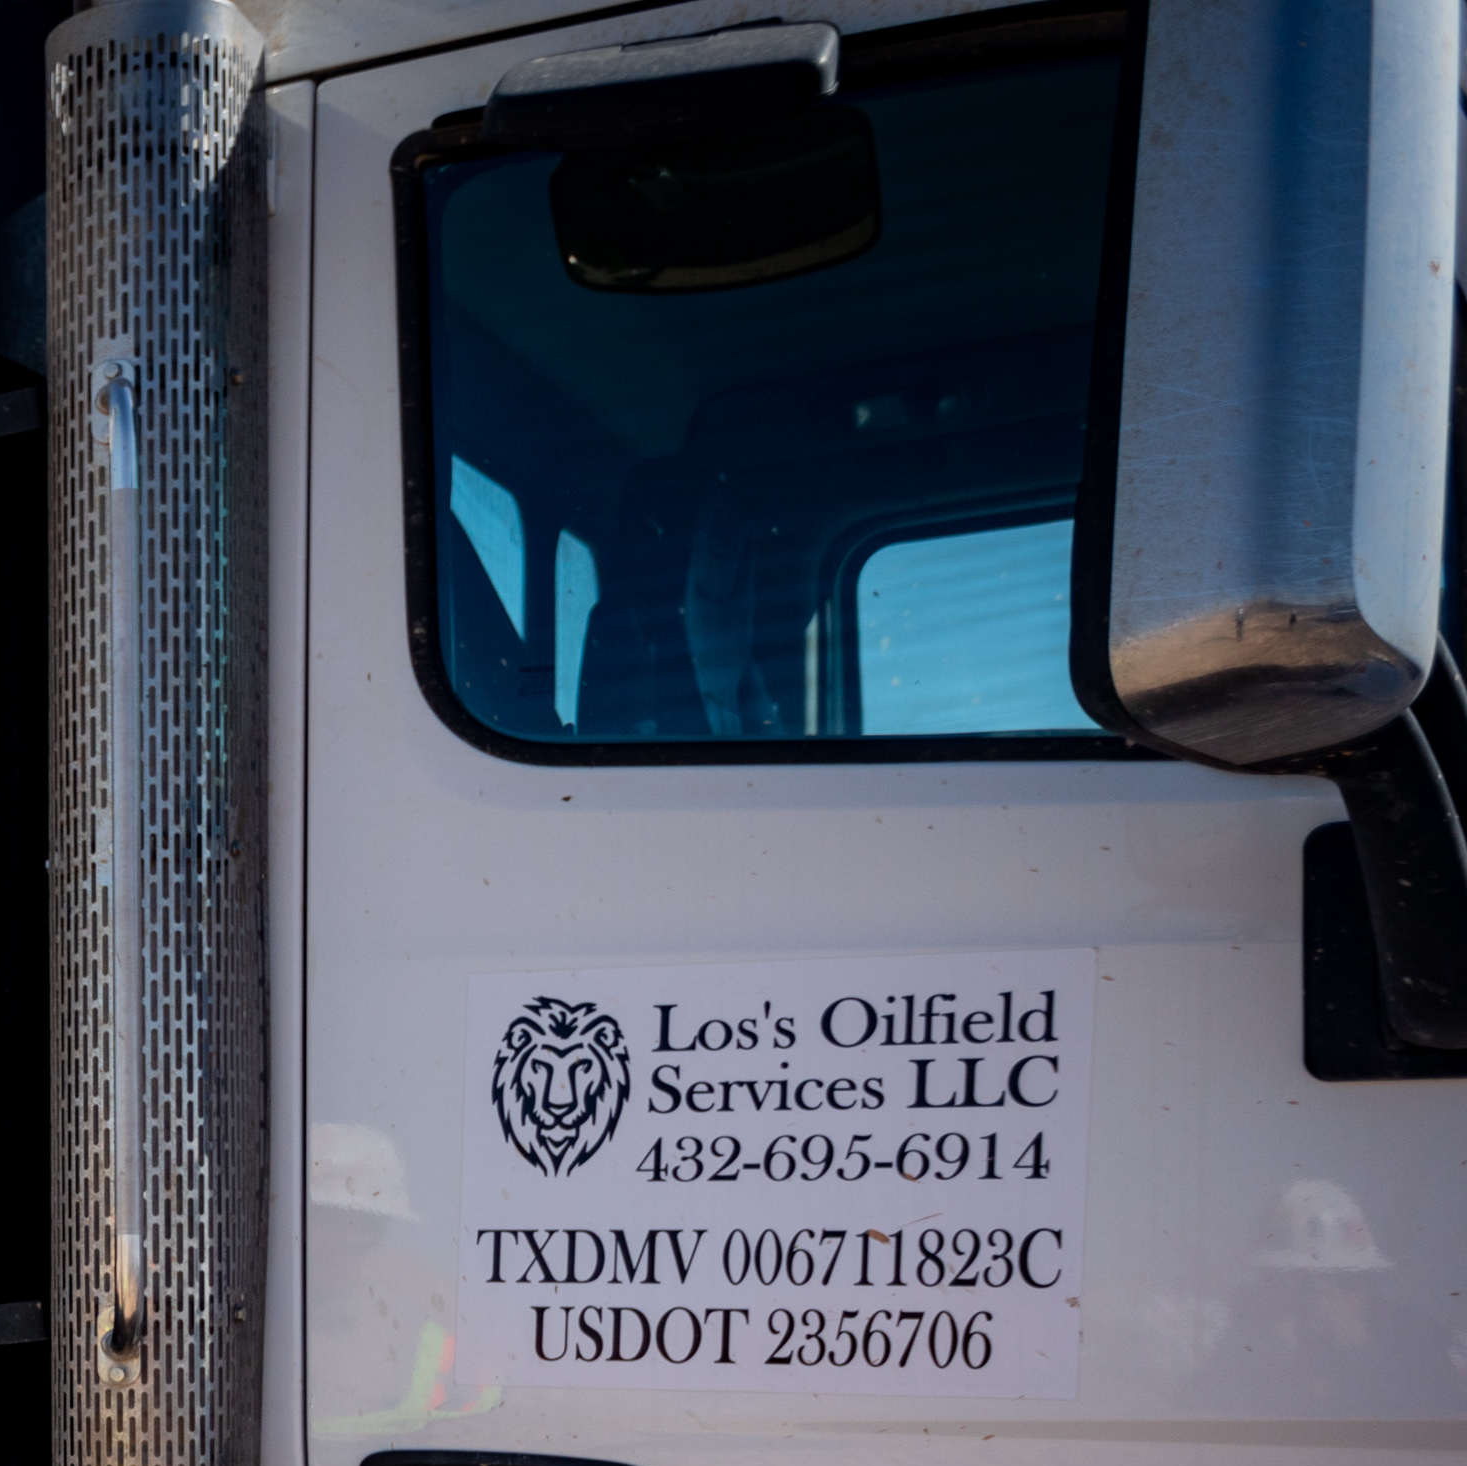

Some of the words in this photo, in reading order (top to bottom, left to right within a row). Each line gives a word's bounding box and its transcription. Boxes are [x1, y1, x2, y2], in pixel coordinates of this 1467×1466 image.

[652, 1000, 797, 1053] Los's
[821, 990, 1059, 1047] Oilfield
[649, 1062, 885, 1113] Services
[908, 1055, 1059, 1109] LLC
[637, 1132, 1050, 1182] 432-695-6914
[477, 1229, 708, 1285] TXDMV
[723, 1228, 1063, 1289] 006711823C
[531, 1306, 750, 1364] USDOT
[765, 1309, 993, 1369] 2356706
